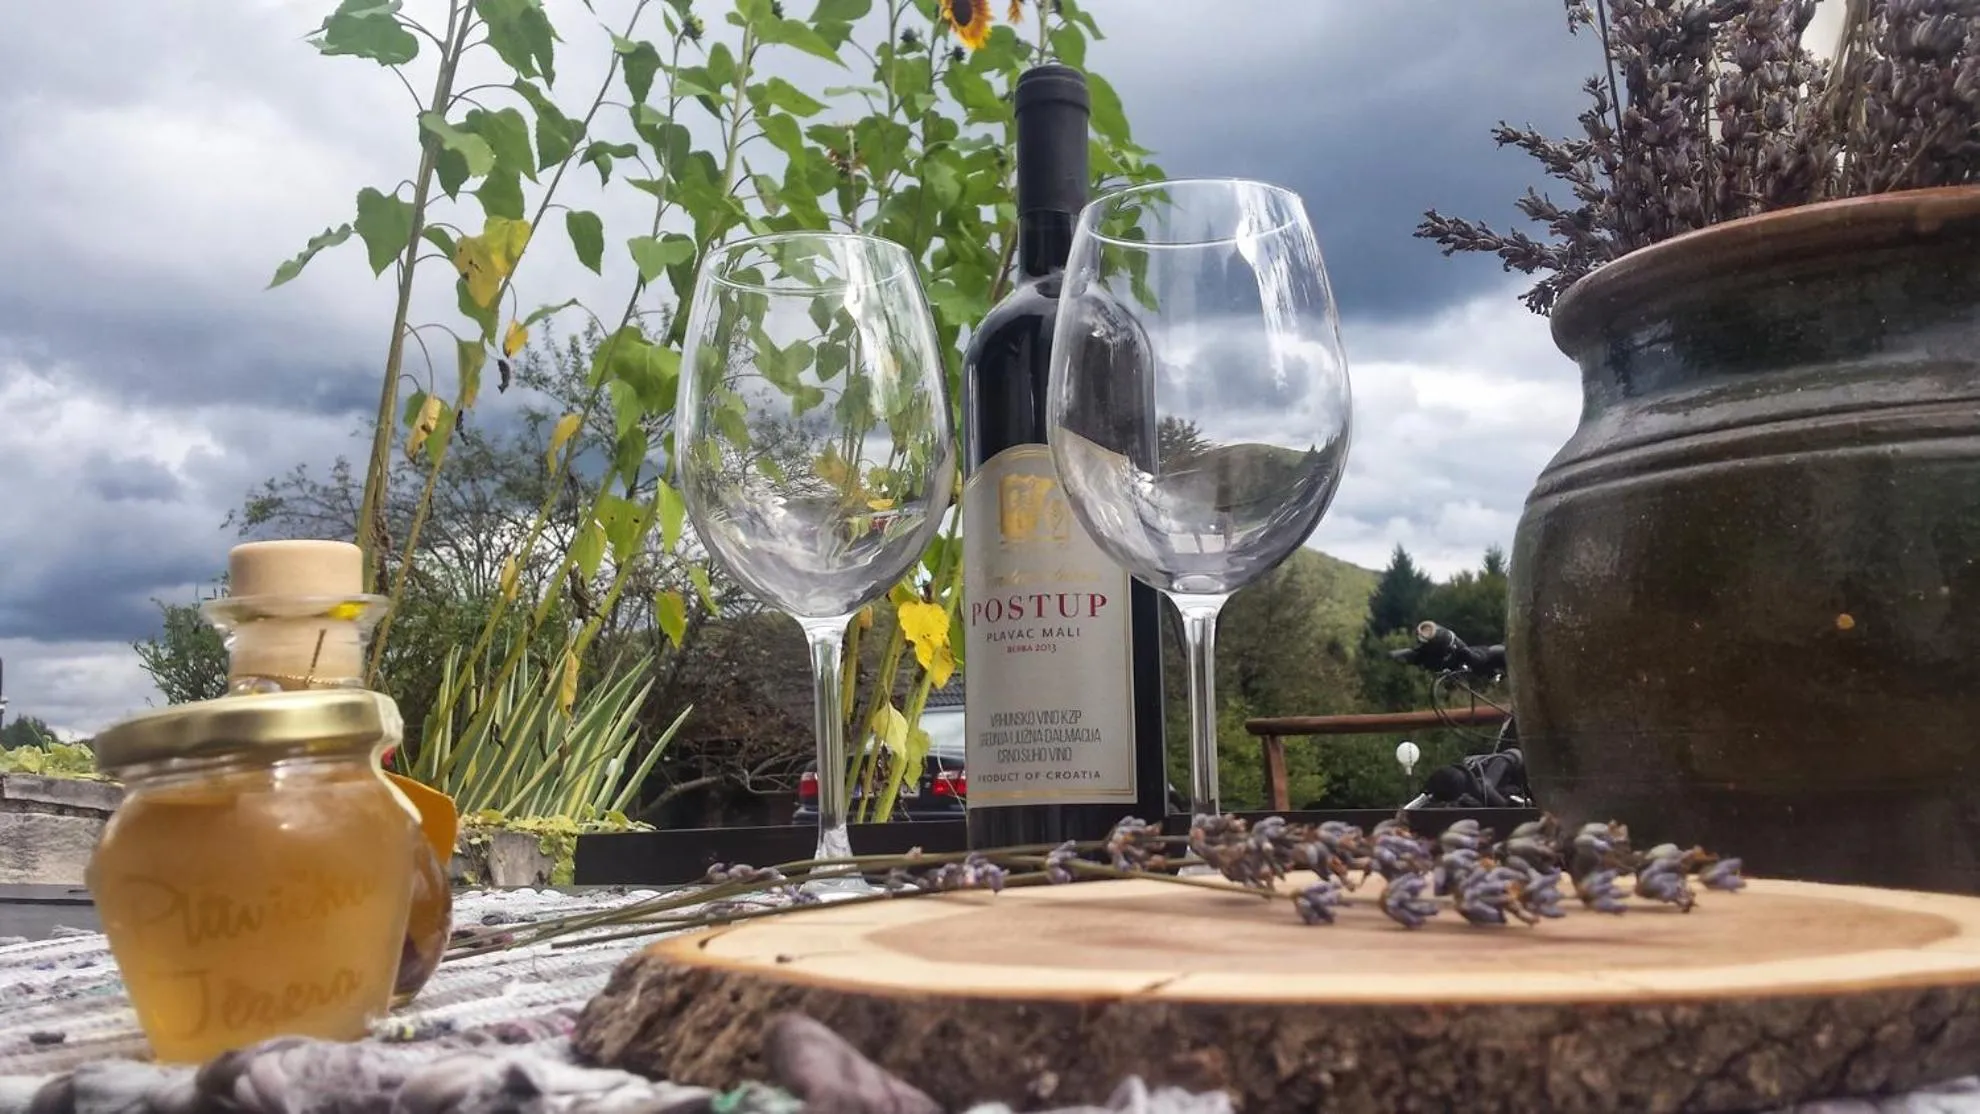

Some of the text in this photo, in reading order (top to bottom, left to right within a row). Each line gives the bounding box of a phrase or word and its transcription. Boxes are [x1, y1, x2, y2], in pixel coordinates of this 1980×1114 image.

[972, 592, 1108, 626] POSTUP
[986, 627, 1080, 642] PLAVAC MALI
[1035, 643, 1057, 654] 2013
[1037, 709, 1060, 725] VINO
[1061, 709, 1082, 724] KZP
[1049, 747, 1072, 762] VINO
[978, 770, 1101, 783] PRODUCT OF CROATIA
